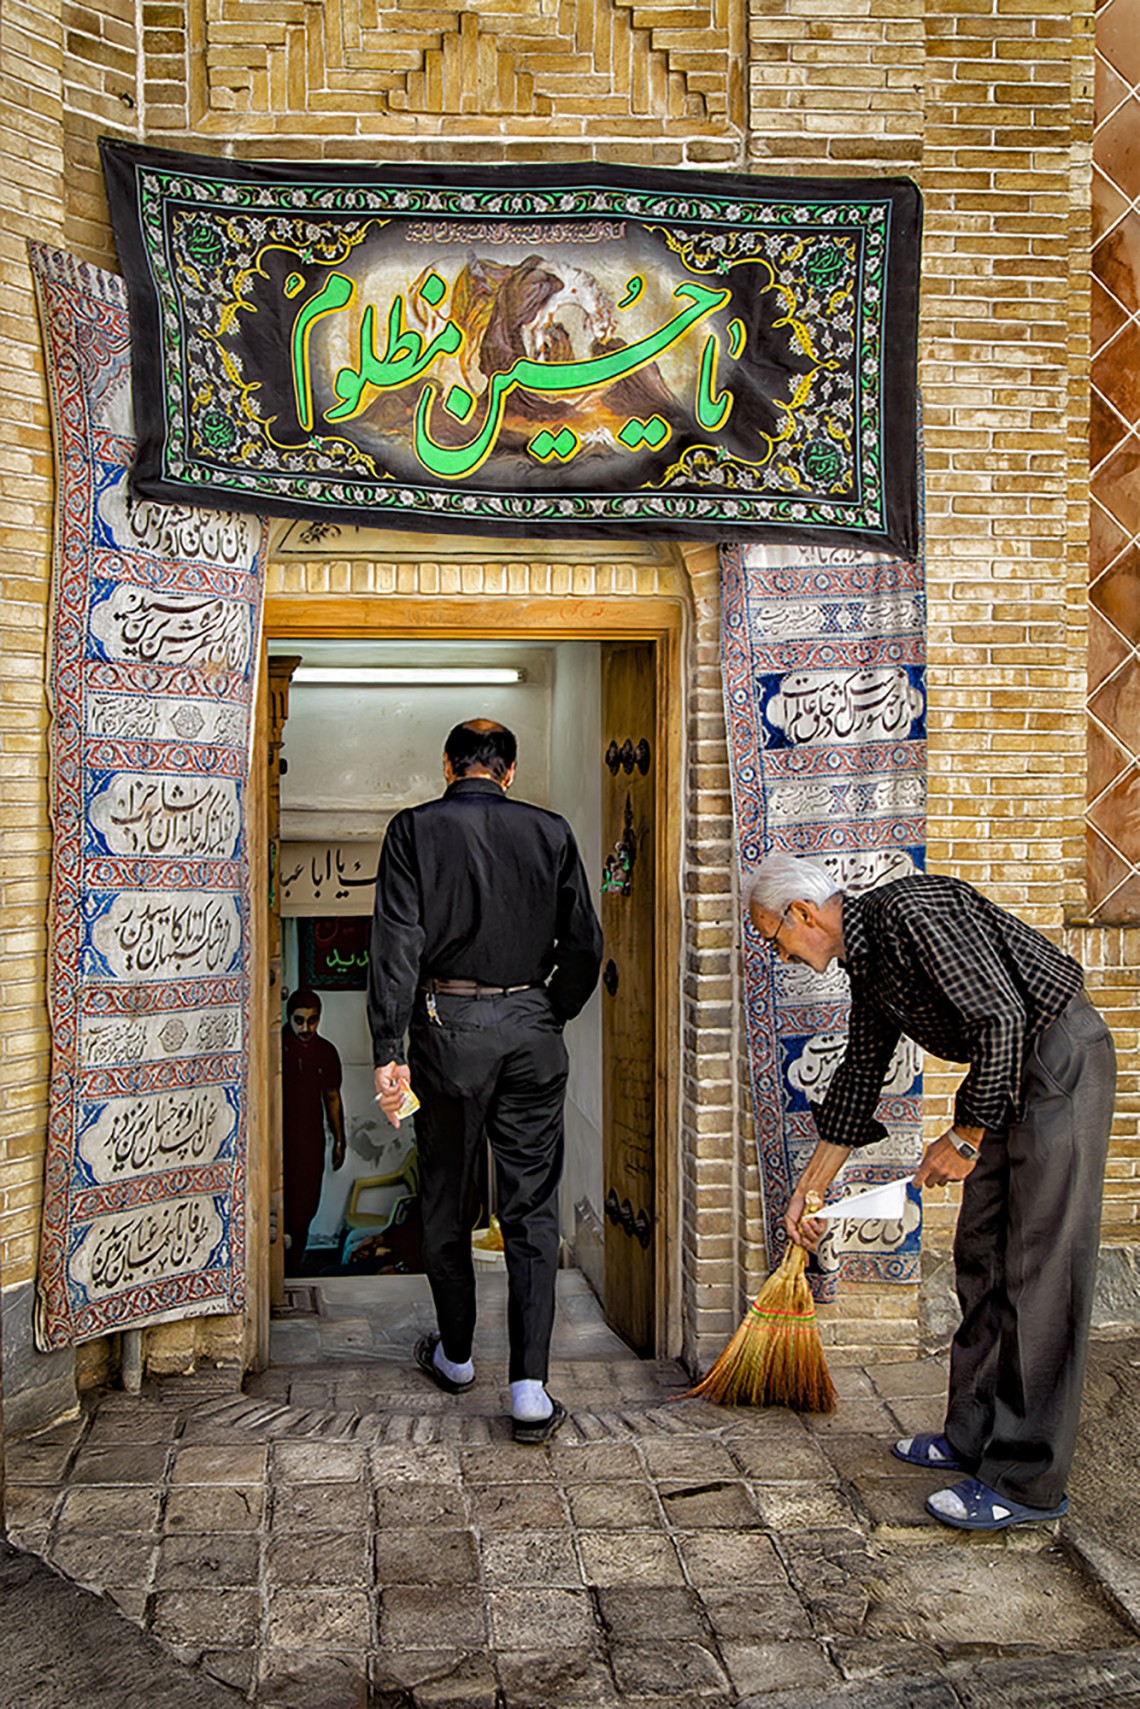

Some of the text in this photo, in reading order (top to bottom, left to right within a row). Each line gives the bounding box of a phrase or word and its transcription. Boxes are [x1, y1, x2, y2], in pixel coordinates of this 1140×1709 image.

[292, 273, 742, 479] یا حسین مظلوم
